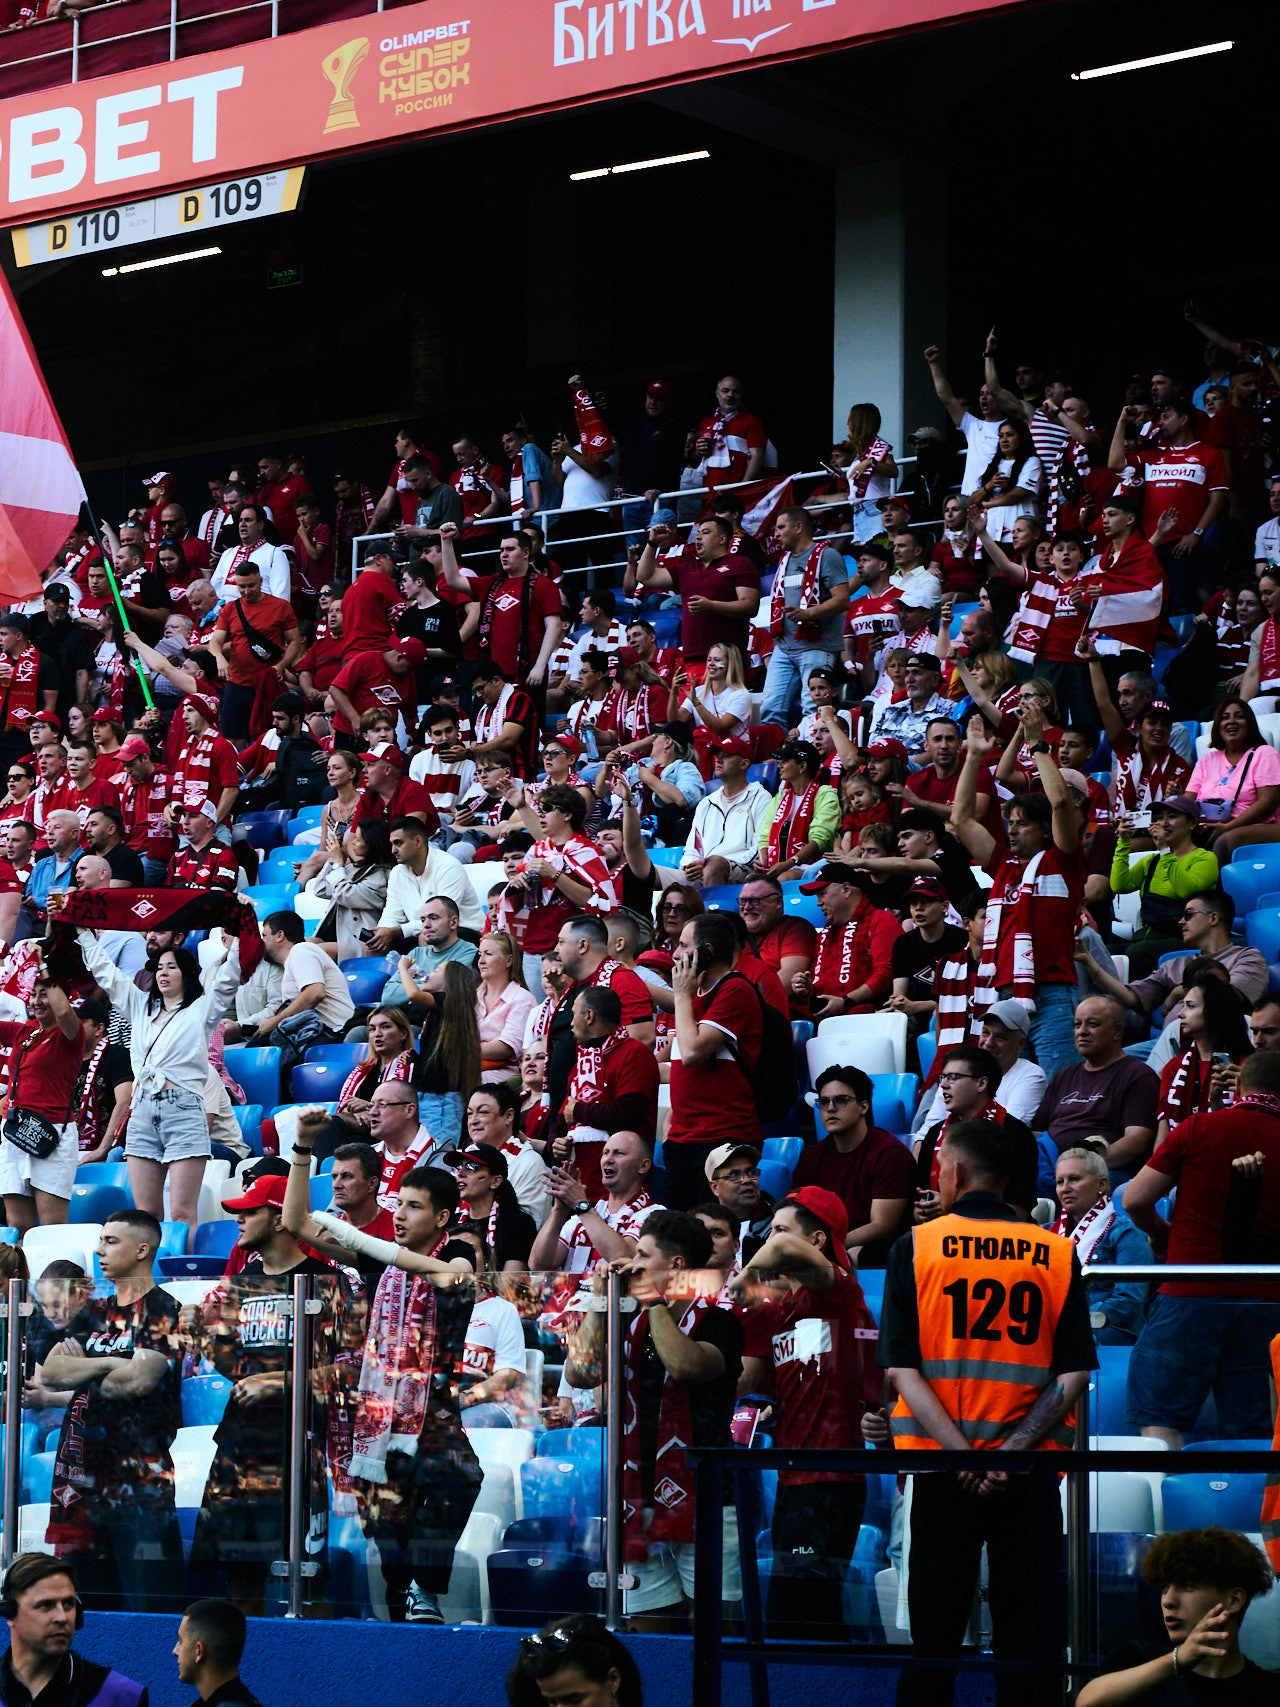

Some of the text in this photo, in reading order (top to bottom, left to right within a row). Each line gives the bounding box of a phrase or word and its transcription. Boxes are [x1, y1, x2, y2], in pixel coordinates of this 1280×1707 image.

[379, 20, 470, 52] OLIMPBET
[379, 37, 470, 78] СУПЕР
[378, 62, 470, 104] КУБОК
[395, 92, 453, 116] РОССИИ
[184, 178, 262, 222] D 109
[52, 209, 120, 250] D 110
[1150, 467, 1196, 478] ЛУКОЙЛ
[839, 921, 857, 984] СПАРТАК
[19, 1125, 42, 1143] GUESS
[942, 1235, 1050, 1270] СТЮАРД
[943, 1277, 1044, 1346] 129
